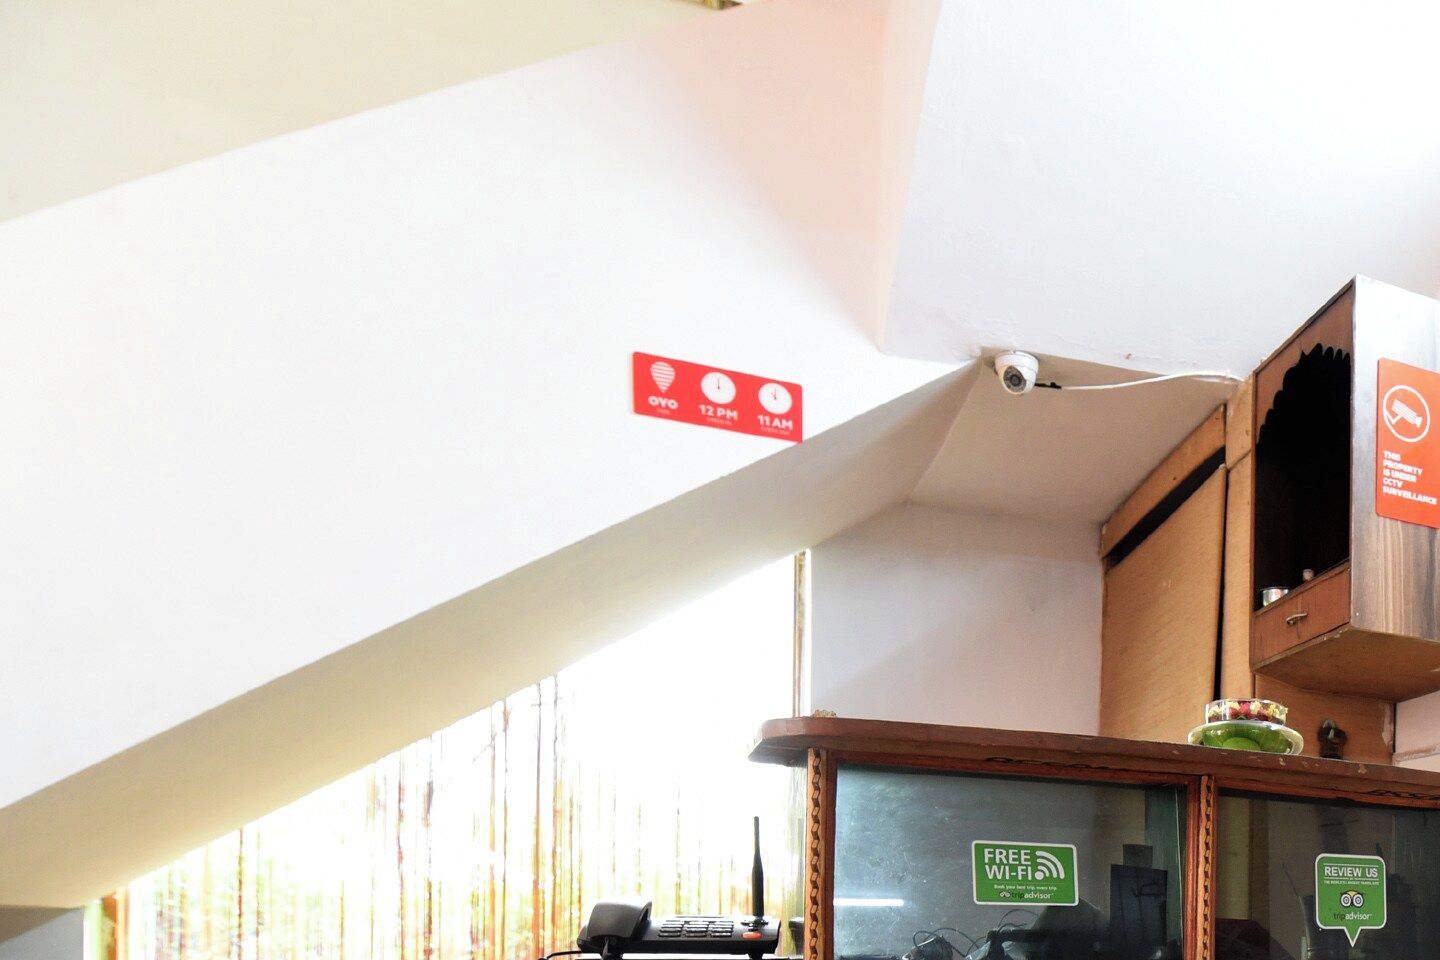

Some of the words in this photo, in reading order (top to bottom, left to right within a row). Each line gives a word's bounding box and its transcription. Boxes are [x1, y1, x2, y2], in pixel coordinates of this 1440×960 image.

[648, 395, 678, 410] OYO
[699, 404, 715, 417] 12
[717, 408, 738, 421] PM
[757, 415, 770, 426] 11
[772, 419, 793, 430] AM
[1383, 450, 1401, 461] THIS
[1383, 459, 1423, 475] PROPERTY
[1383, 468, 1391, 476] IS
[1391, 469, 1417, 483] UNDER
[1383, 477, 1402, 488] CCTV
[1383, 485, 1438, 505] SURVEILLANCE
[984, 848, 1031, 865] FREE
[985, 865, 1032, 881] WI-FI
[1324, 866, 1362, 877] REVIEW
[1365, 868, 1378, 878] US
